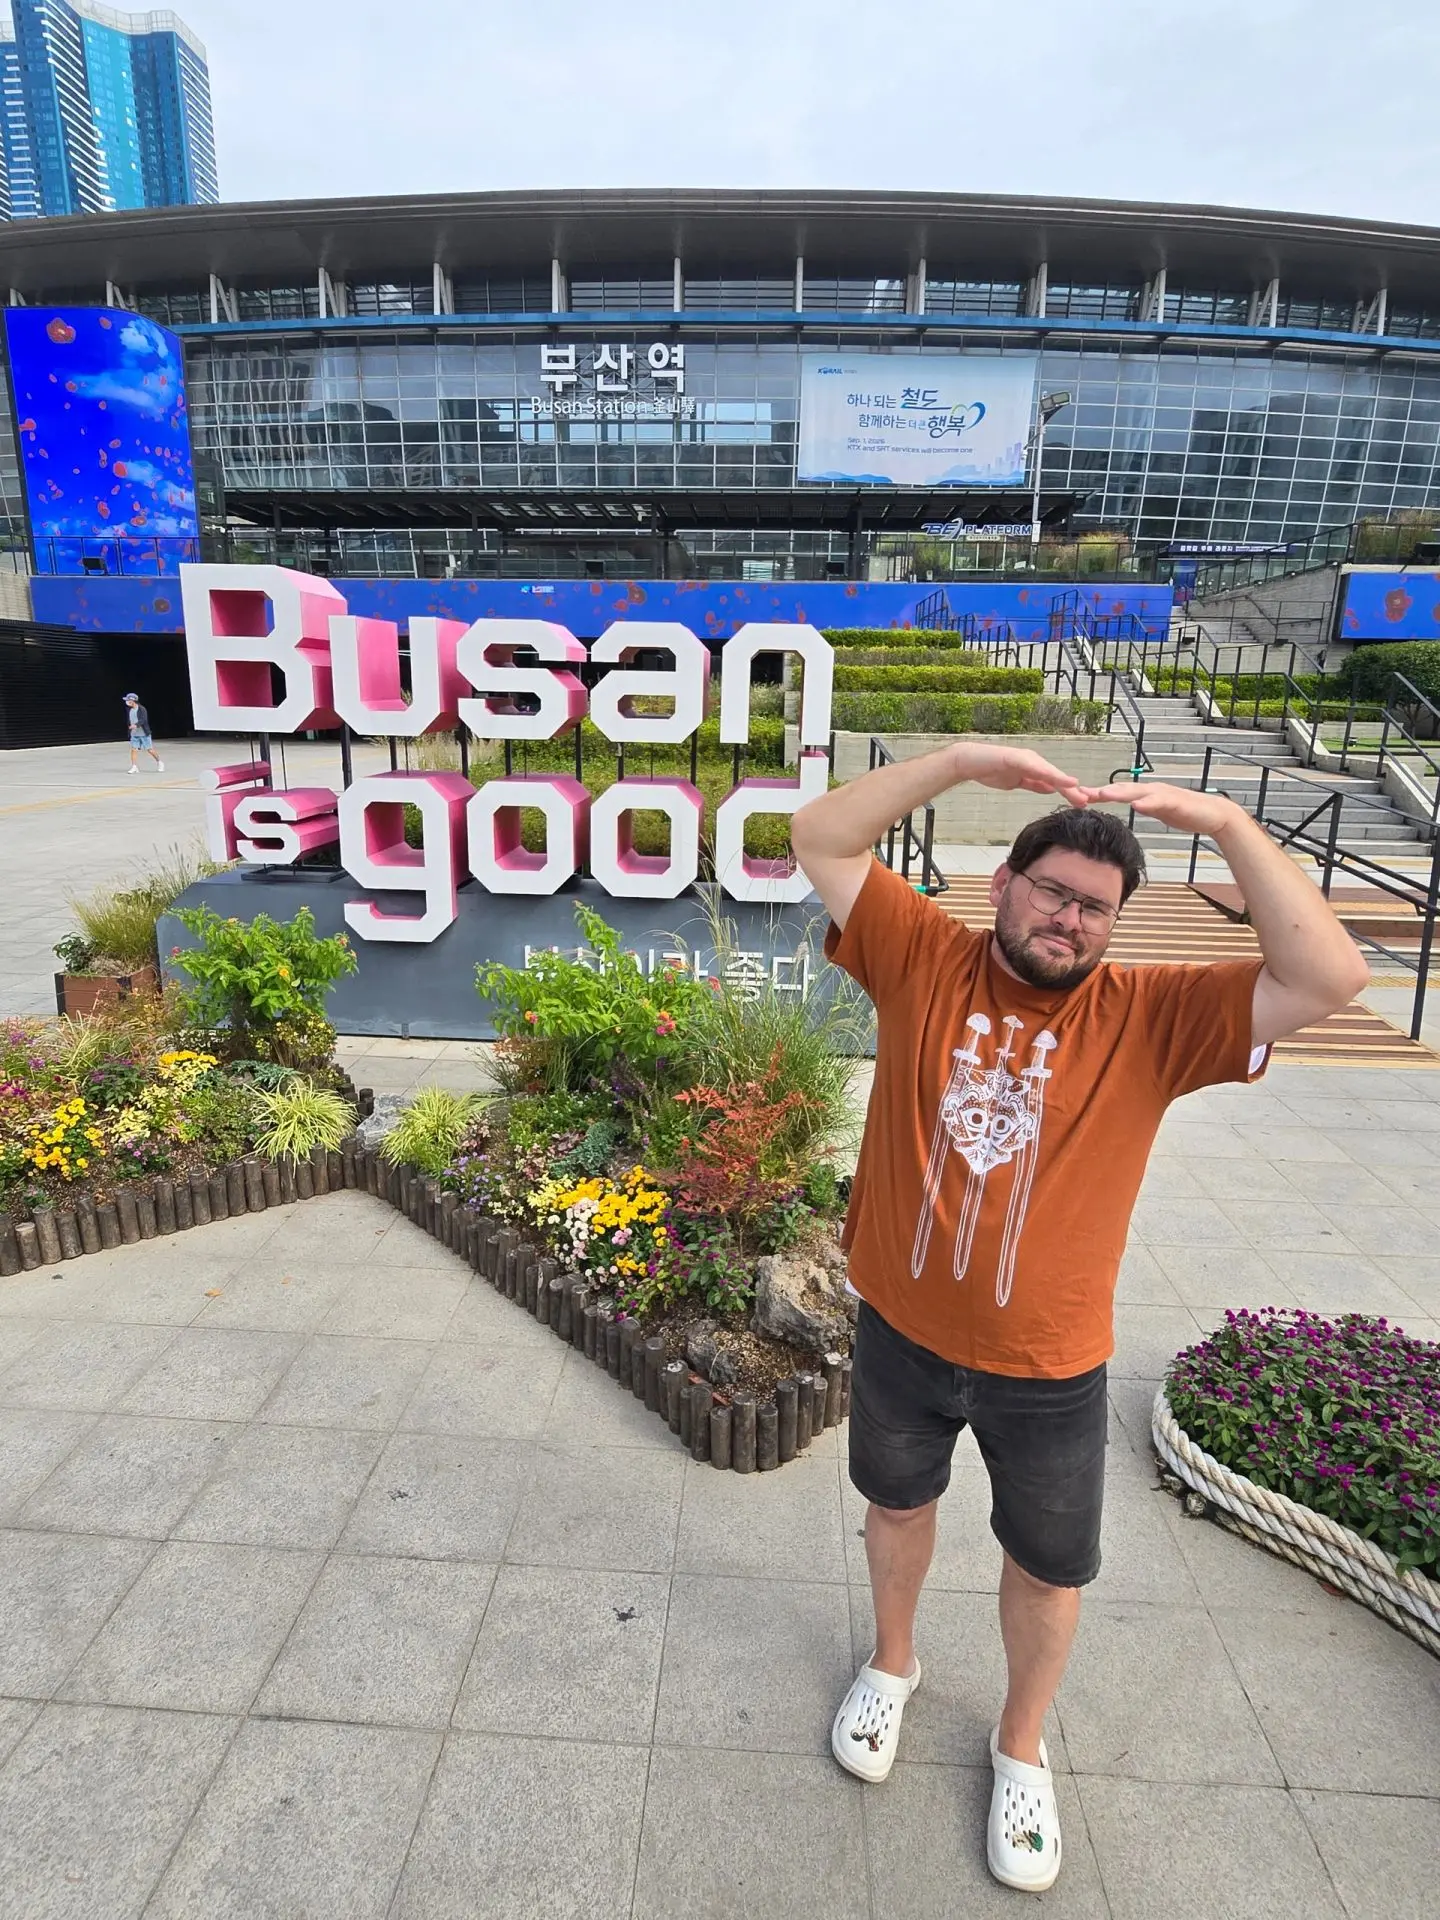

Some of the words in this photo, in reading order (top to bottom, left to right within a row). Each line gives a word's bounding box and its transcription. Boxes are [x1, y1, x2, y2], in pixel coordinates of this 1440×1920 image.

[540, 343, 685, 393] 부산역
[531, 396, 582, 414] Busan
[586, 396, 648, 415] Station
[847, 393, 872, 408] 하나
[874, 394, 897, 409] 되는
[900, 387, 945, 411] 철도
[859, 413, 907, 430] 함께하는
[927, 415, 967, 439] 행복
[876, 445, 890, 453] SRT
[891, 446, 920, 454] services
[965, 524, 1033, 536] PLATFORM
[179, 563, 835, 746] Busan
[199, 764, 308, 865] is
[338, 751, 830, 944] good
